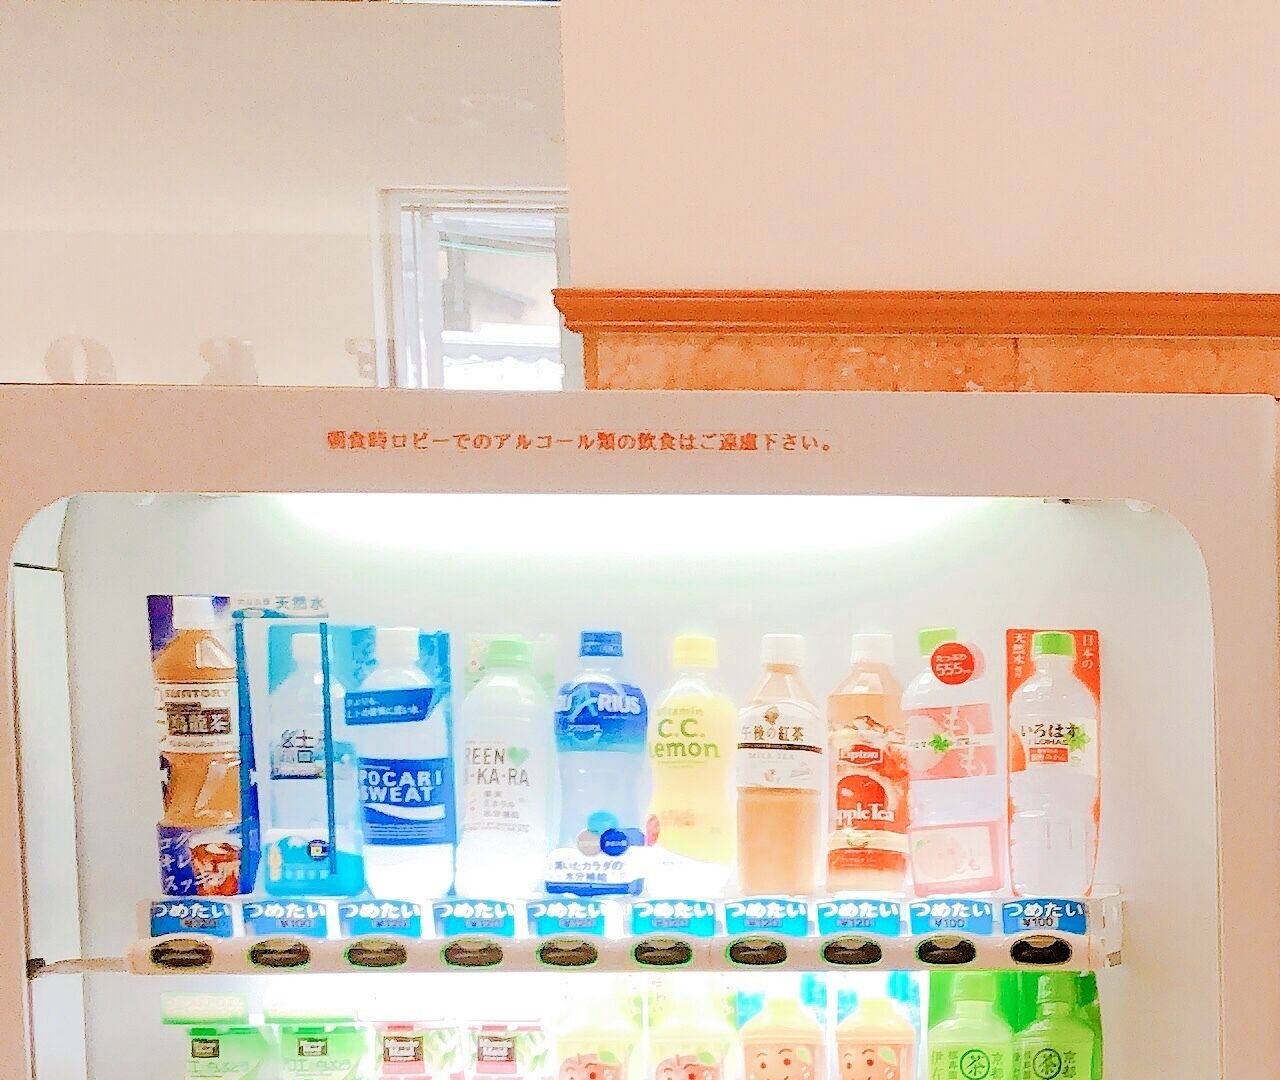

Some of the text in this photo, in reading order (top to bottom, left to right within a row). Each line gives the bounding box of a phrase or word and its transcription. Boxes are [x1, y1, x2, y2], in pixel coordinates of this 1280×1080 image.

[658, 718, 705, 738] C.C.
[1021, 723, 1079, 738] いろはす
[843, 751, 878, 759] Lipton
[868, 803, 894, 821] Tea
[155, 904, 231, 918] つめたい
[249, 904, 326, 918] つめたい
[910, 902, 991, 919] つめたい
[1003, 902, 1084, 919] つめたい
[1022, 917, 1054, 928] ¥100
[1037, 1053, 1057, 1075] 茶
